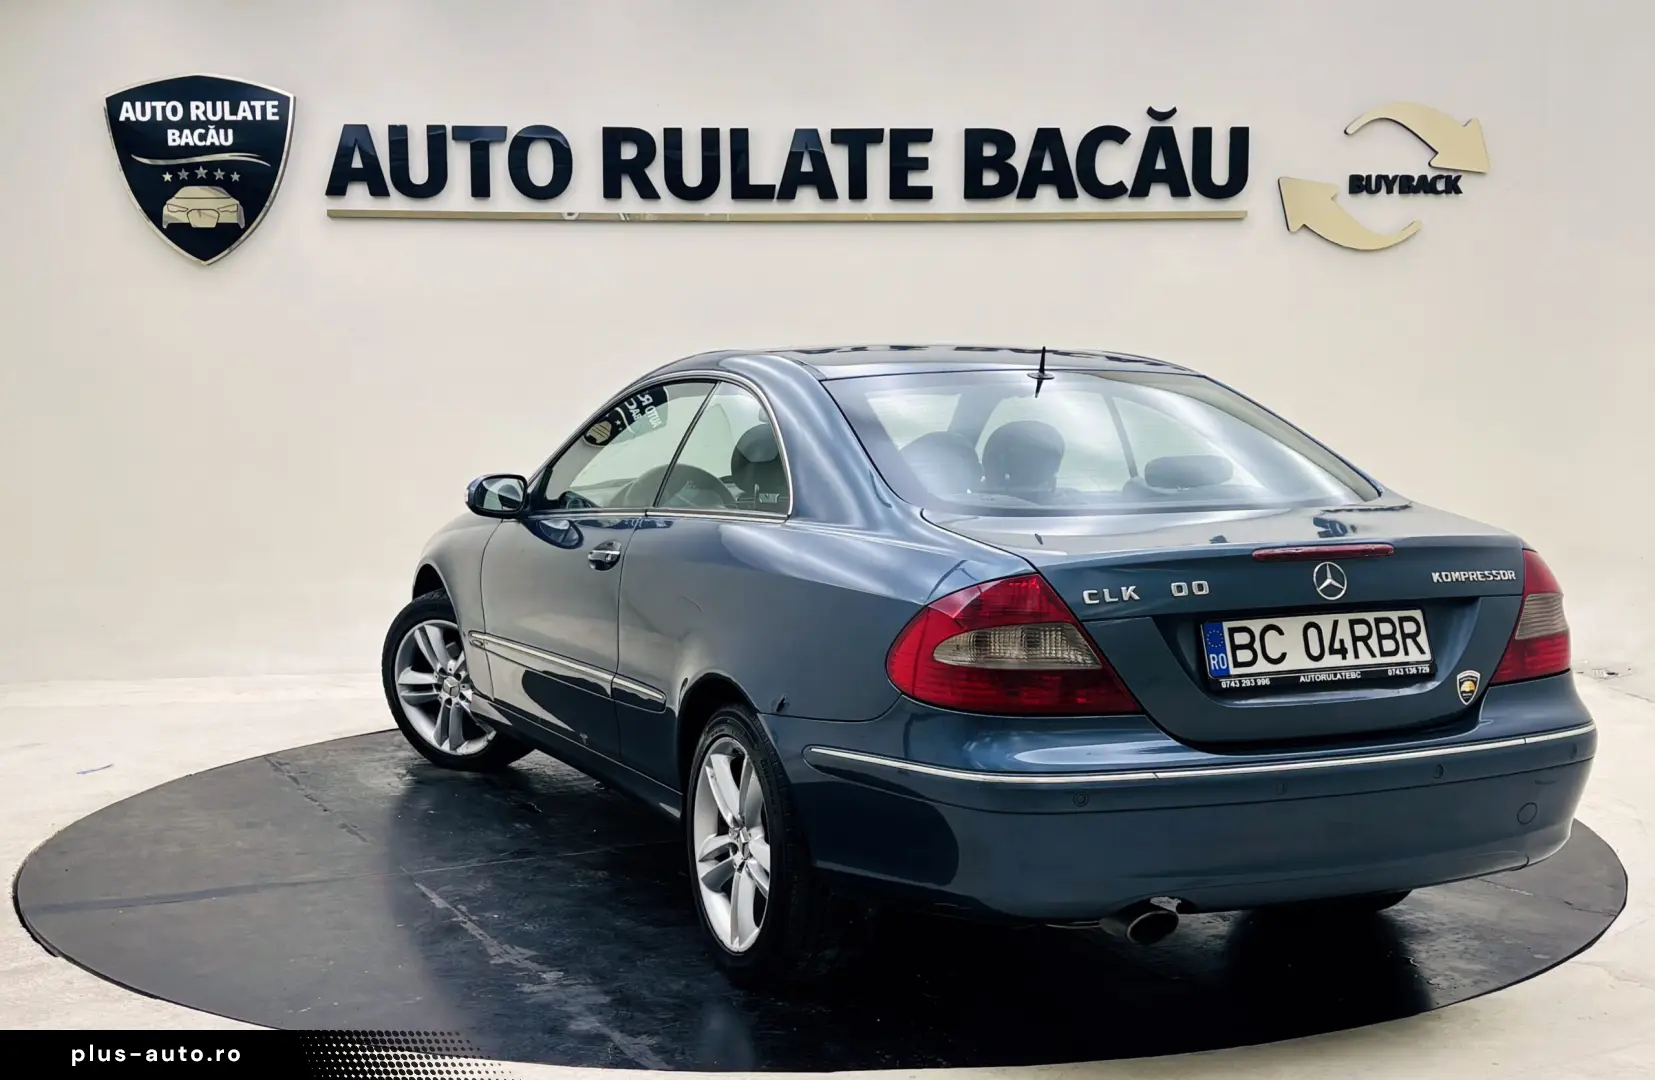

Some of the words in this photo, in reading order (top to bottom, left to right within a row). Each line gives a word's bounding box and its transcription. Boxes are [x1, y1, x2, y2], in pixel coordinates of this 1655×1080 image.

[119, 101, 183, 122] AUTO
[190, 101, 280, 121] RULATE
[167, 125, 233, 146] BACĂU
[325, 124, 573, 200] AUTO
[602, 126, 934, 200] RULATE
[963, 106, 1250, 200] BACĂU
[1348, 174, 1463, 195] BUYBACK
[1431, 570, 1516, 583] KOMPRESSOR
[1082, 585, 1140, 605] CLK
[1227, 624, 1287, 668] BC
[1302, 615, 1427, 662] 04RBR
[1209, 653, 1228, 670] RO
[1299, 671, 1362, 683] AUTORULATEBC
[1387, 668, 1404, 676] 0743
[1221, 680, 1240, 689] 0743
